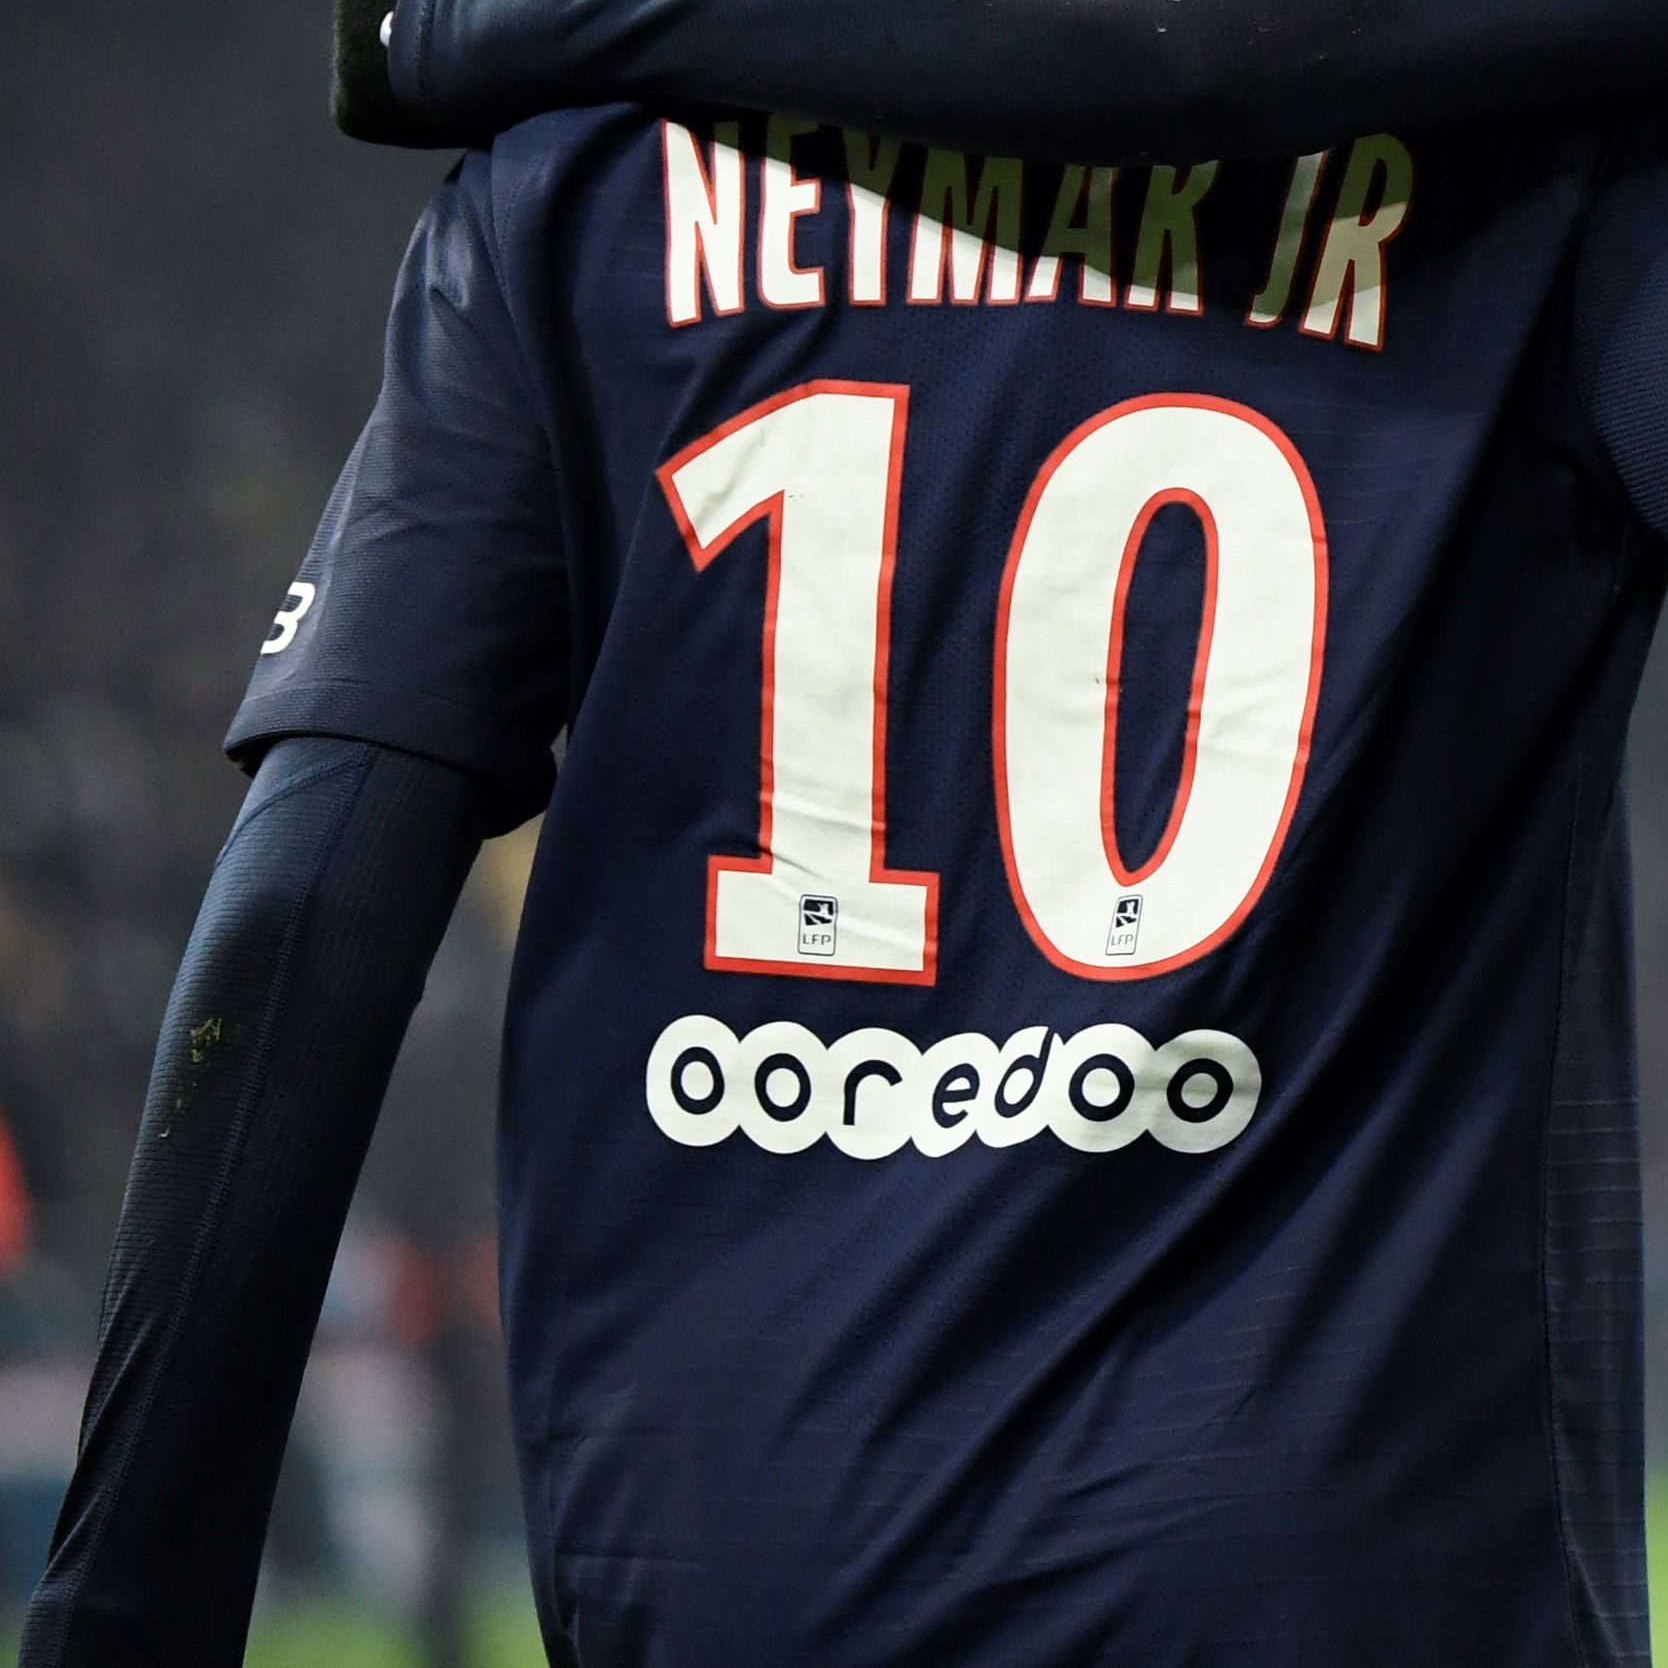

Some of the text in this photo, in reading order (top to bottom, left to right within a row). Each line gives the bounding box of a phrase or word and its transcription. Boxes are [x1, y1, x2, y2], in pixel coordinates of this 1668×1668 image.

[661, 113, 1414, 352] NEYMAR JR
[656, 379, 1328, 983] 10
[802, 933, 832, 946] LFP
[1110, 934, 1135, 947] LFP
[669, 1026, 1234, 1132] ooredoo
